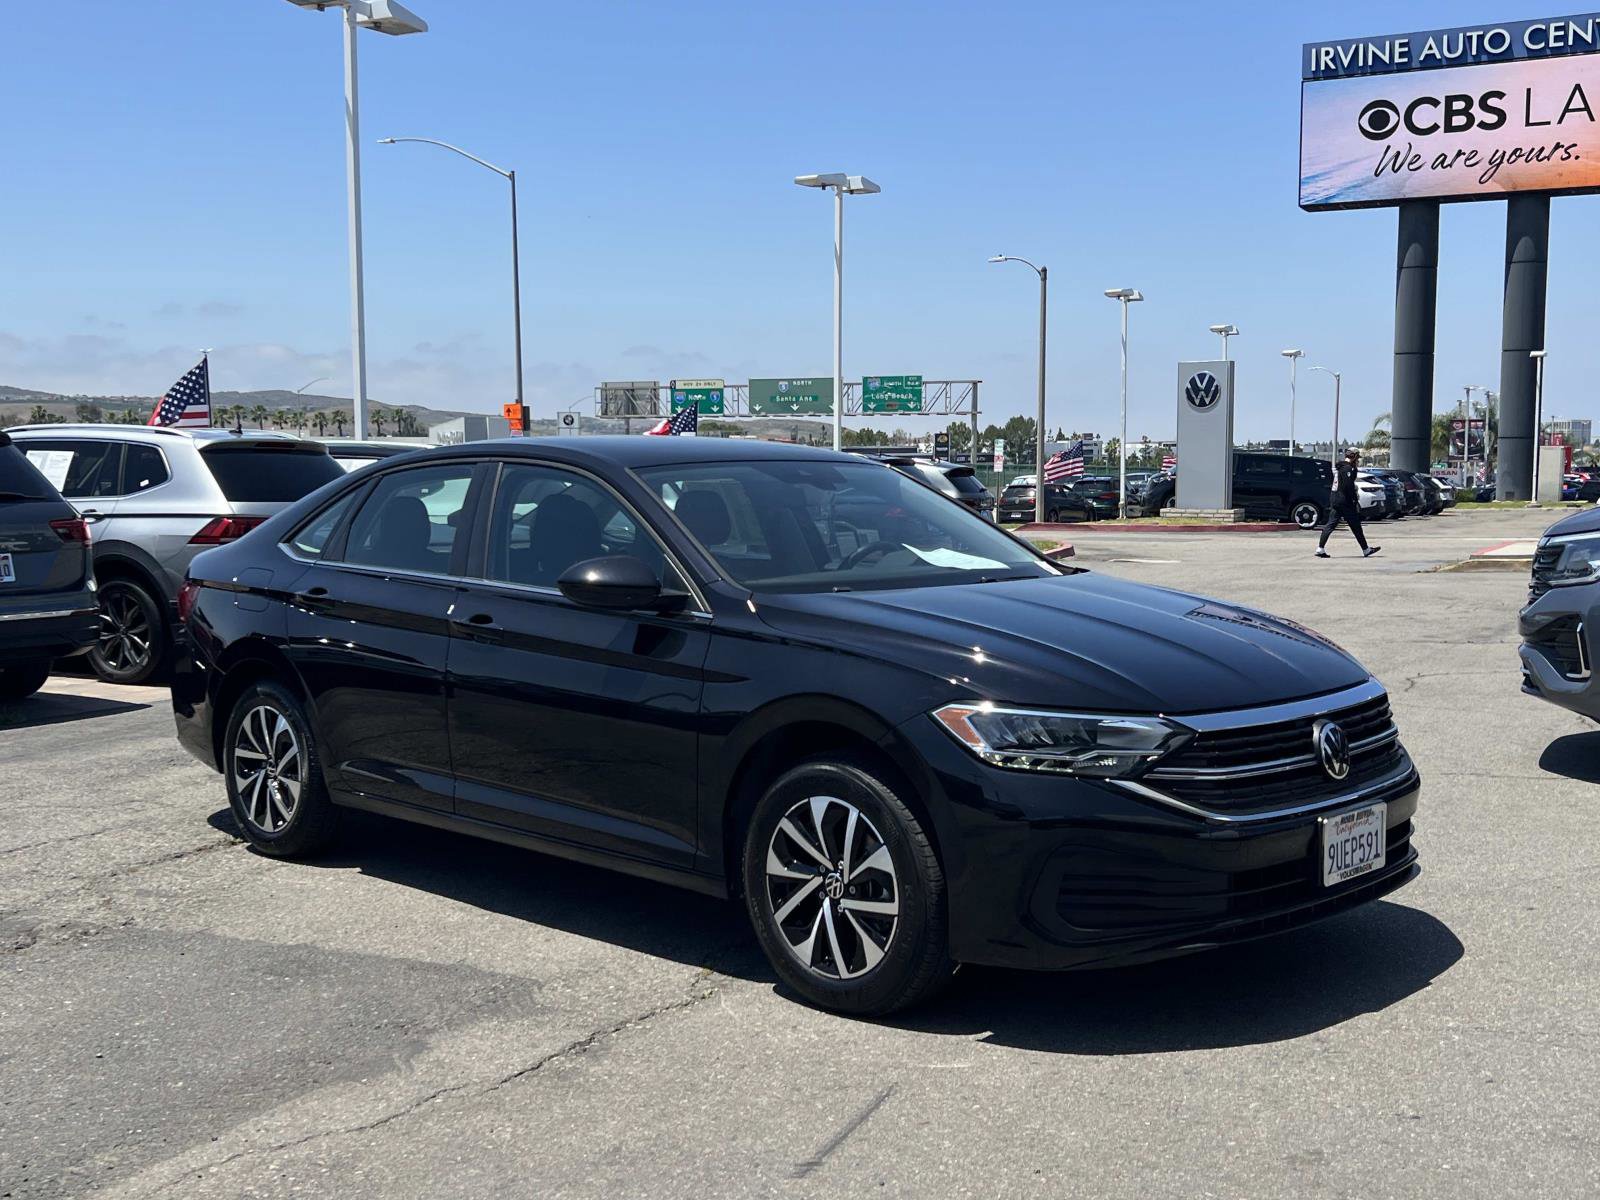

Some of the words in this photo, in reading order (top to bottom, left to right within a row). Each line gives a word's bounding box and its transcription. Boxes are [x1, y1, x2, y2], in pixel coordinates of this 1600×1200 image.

[1310, 39, 1409, 72] IRVINE
[1419, 28, 1511, 61] AUTO
[1523, 18, 1600, 50] CEN
[1404, 91, 1507, 136] CBS
[1525, 83, 1596, 127] LA
[1374, 143, 1426, 177] We
[1431, 149, 1483, 171] are
[1479, 141, 1580, 185] yours.
[1328, 830, 1380, 875] 9UEP591
[1340, 862, 1374, 880] VOLKSWAGEN
